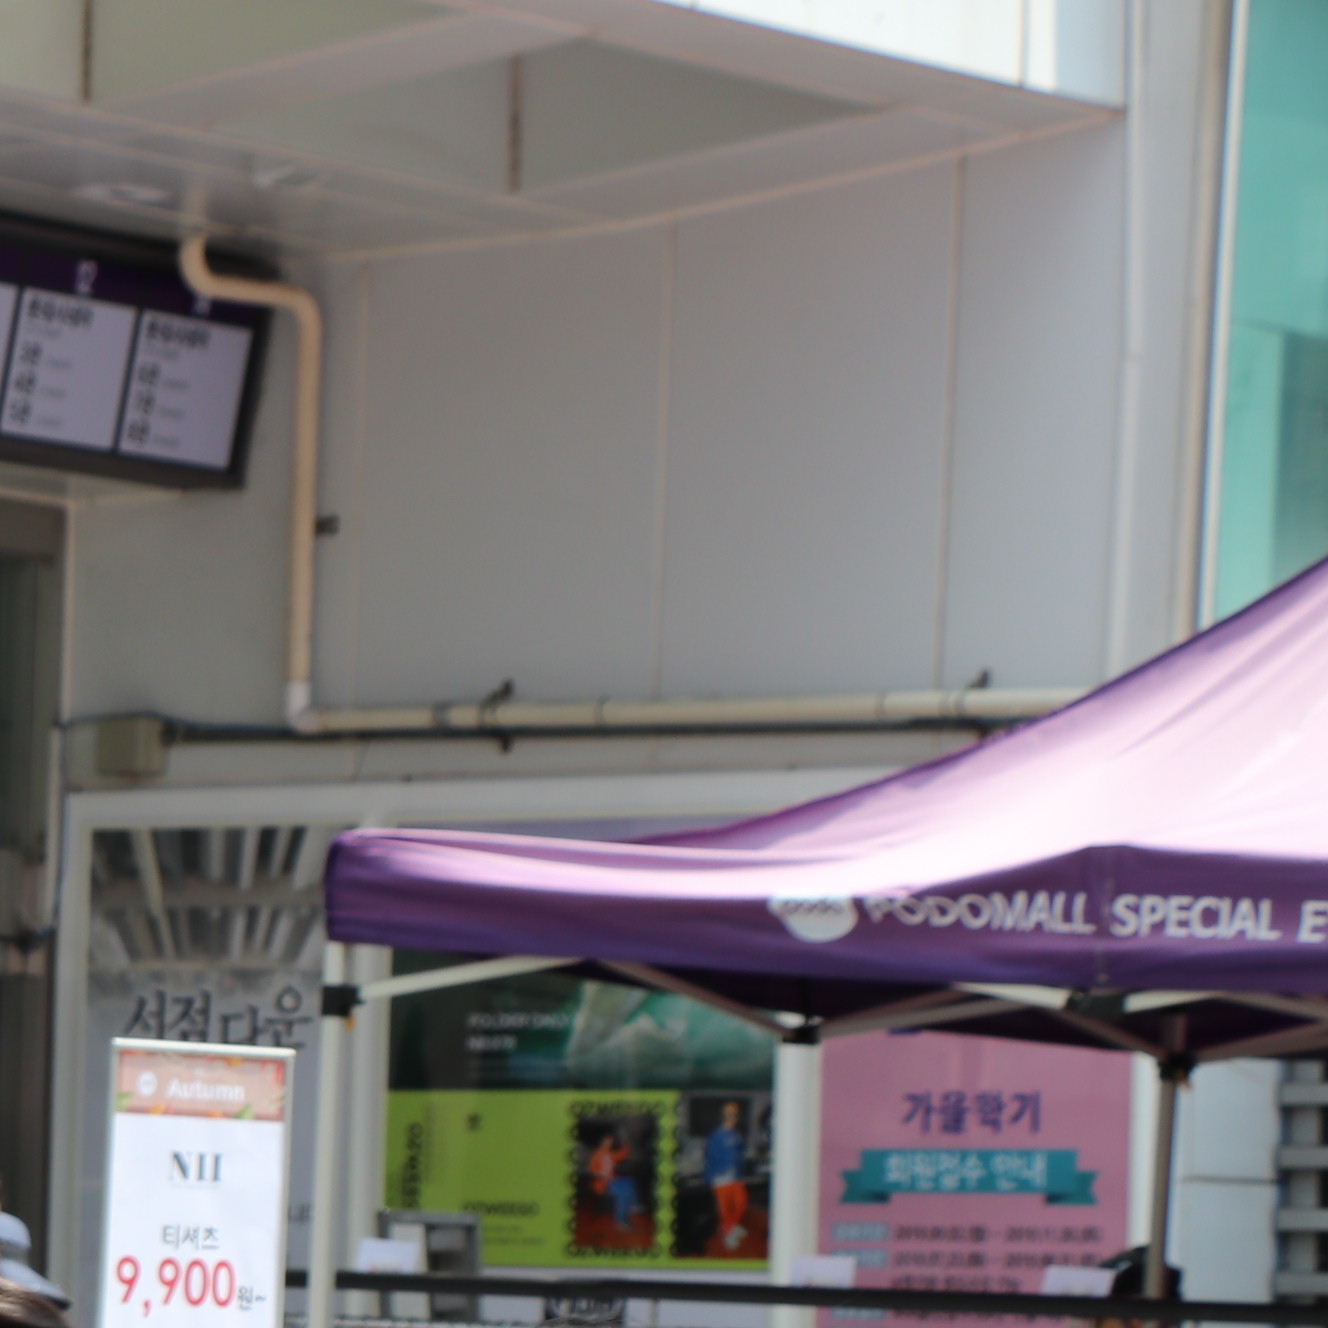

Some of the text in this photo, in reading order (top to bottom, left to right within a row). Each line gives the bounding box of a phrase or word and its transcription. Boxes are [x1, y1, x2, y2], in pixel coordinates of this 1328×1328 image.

[861, 889, 1096, 936] PODOMALL
[1108, 893, 1283, 942] SPECIAL
[166, 1078, 246, 1102] Autumn
[902, 1090, 1043, 1134] 가을학기
[169, 1151, 223, 1182] NII
[991, 1152, 1048, 1188] 안내
[162, 1225, 220, 1252] 티셔츠
